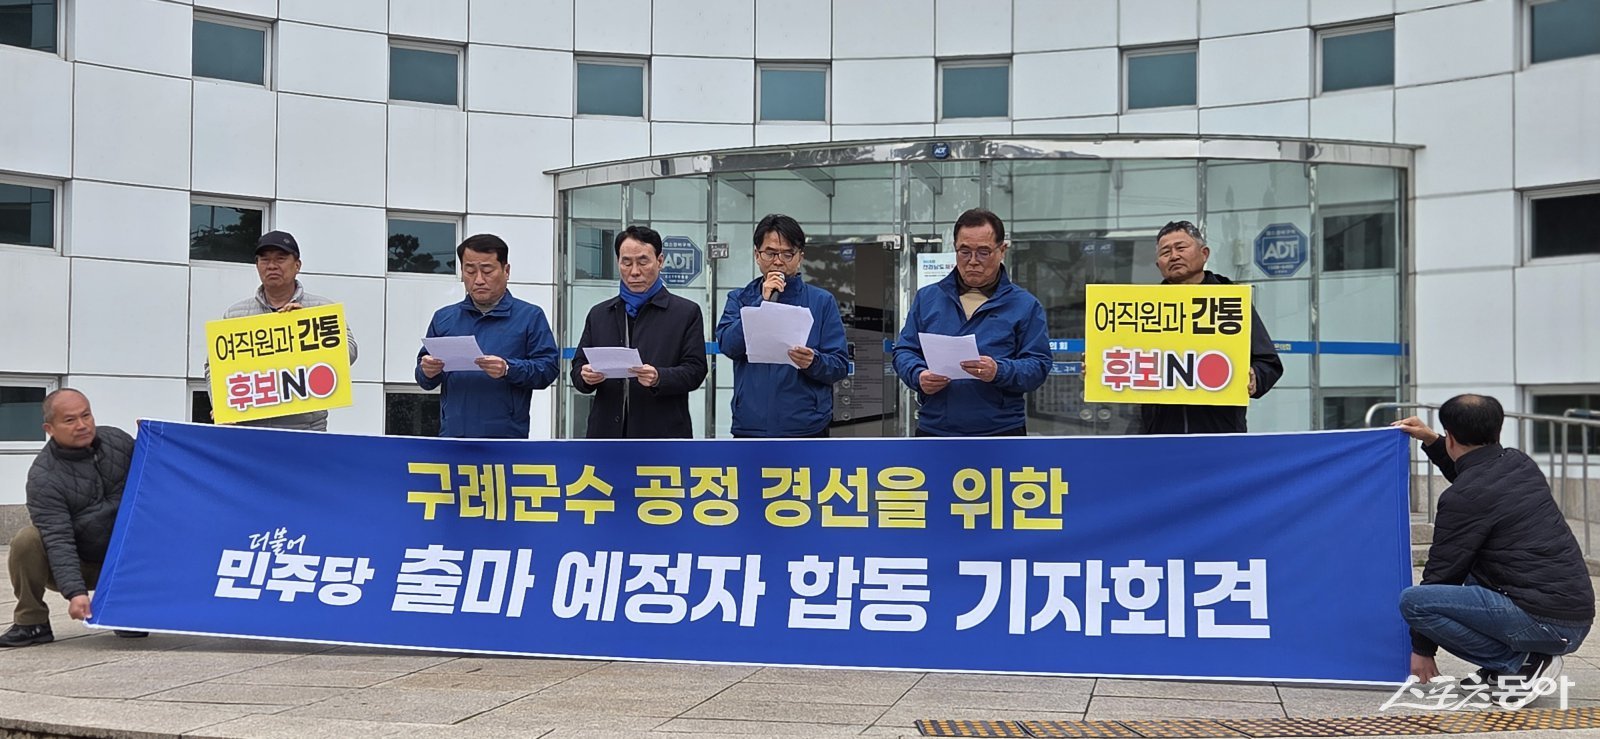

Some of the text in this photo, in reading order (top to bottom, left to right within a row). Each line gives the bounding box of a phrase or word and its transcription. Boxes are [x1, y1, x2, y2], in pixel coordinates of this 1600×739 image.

[662, 253, 694, 269] ADT
[1263, 240, 1299, 260] ADT
[1095, 297, 1243, 335] 여직원과 간통
[215, 314, 341, 361] 여직원과 간통
[1104, 348, 1161, 389] 후보
[228, 370, 279, 410] 후보
[407, 462, 1069, 530] 구례군수 공정 경선을 위한
[249, 527, 306, 556] 더불어
[214, 544, 1271, 639] 민주당 출마 예정자 합동 기자회견
